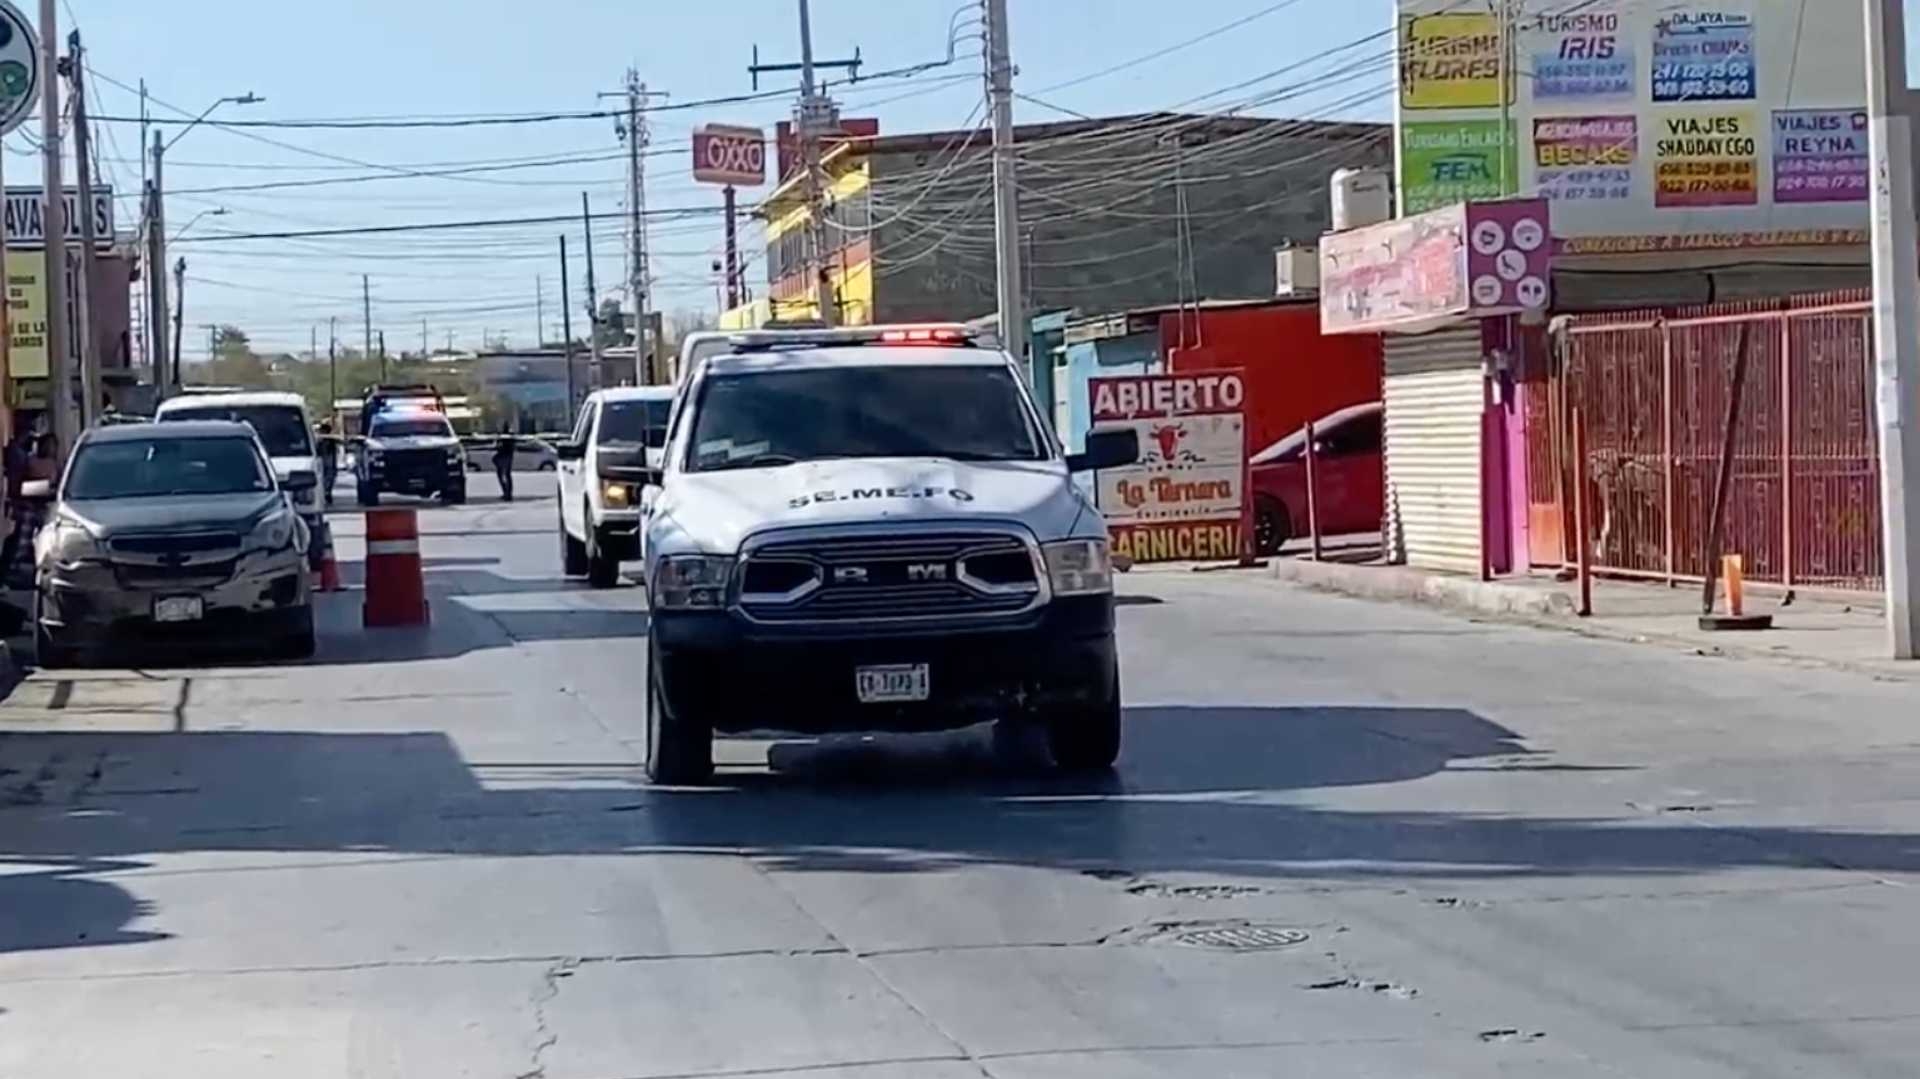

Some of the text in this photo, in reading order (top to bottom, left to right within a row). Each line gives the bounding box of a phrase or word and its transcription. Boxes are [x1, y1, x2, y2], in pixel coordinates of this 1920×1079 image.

[1559, 37, 1615, 59] IRIS
[1407, 58, 1500, 80] FLORES
[1667, 117, 1739, 135] VIAJES
[1777, 115, 1841, 131] VIAJES
[707, 136, 763, 173] OXXO
[1656, 136, 1722, 157] SHADDAY
[1785, 138, 1856, 153] REYNA
[1094, 376, 1244, 414] ABIERTO
[789, 487, 975, 509] SE.ME.FO
[1117, 479, 1146, 508] La
[1109, 525, 1243, 562] ARNICERI
